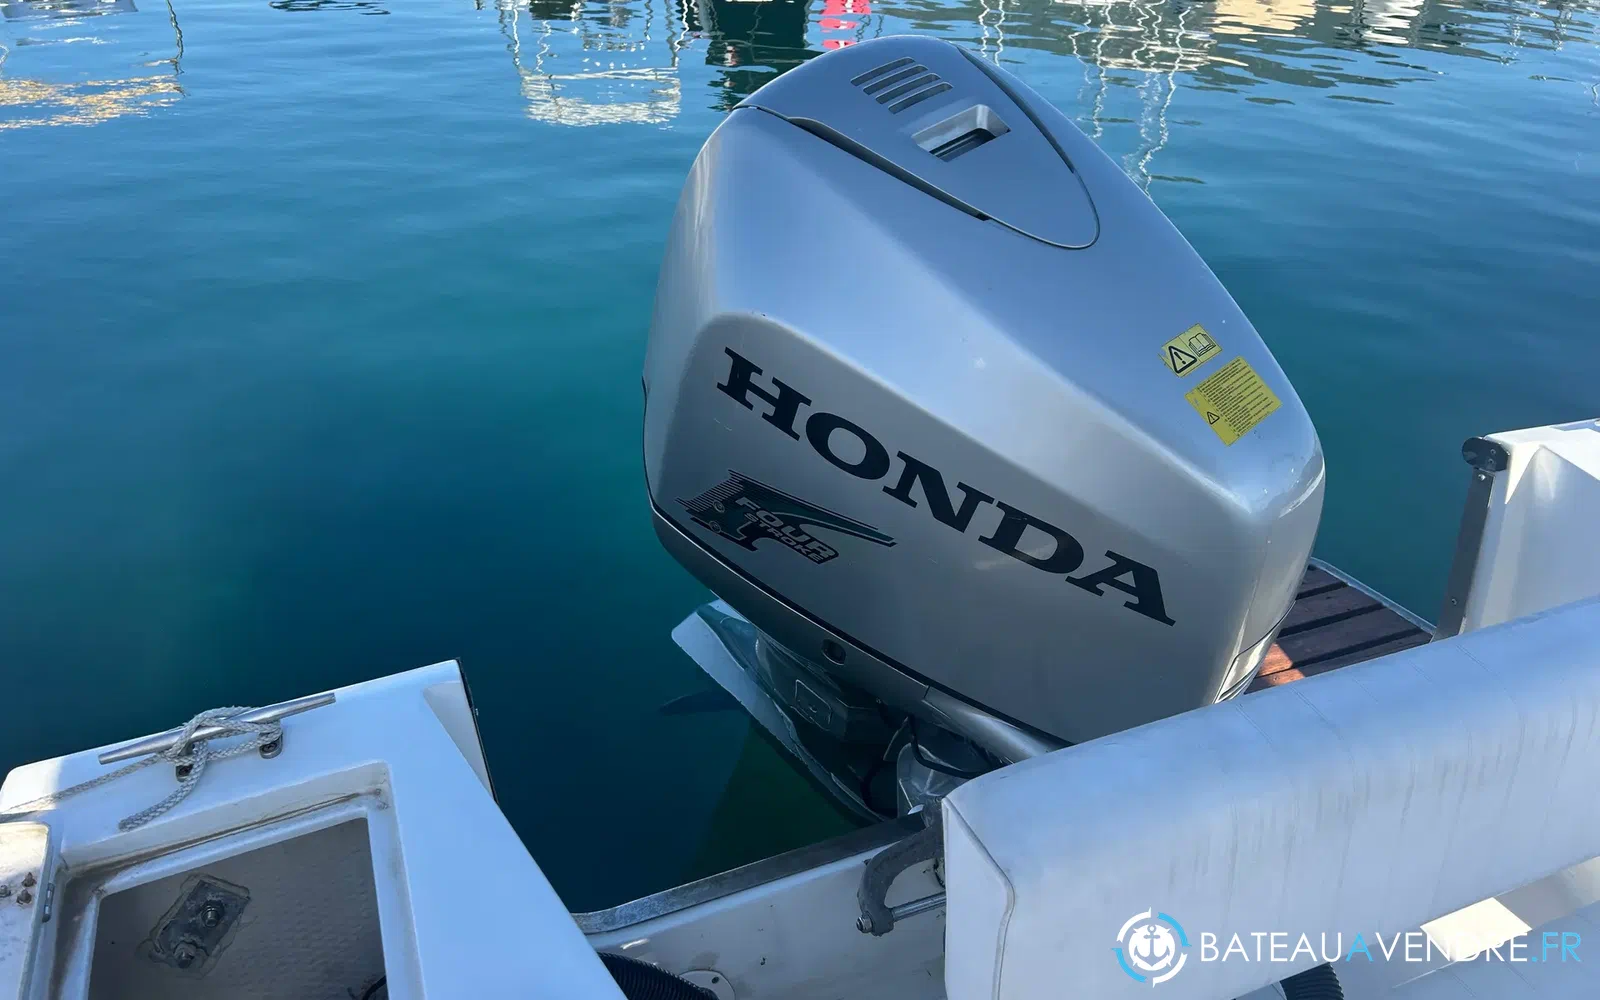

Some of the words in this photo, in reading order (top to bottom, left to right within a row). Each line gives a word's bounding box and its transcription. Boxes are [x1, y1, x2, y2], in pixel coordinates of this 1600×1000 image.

[717, 346, 1176, 626] HONDA
[735, 497, 836, 558] FOUR
[744, 513, 824, 562] STROKE
